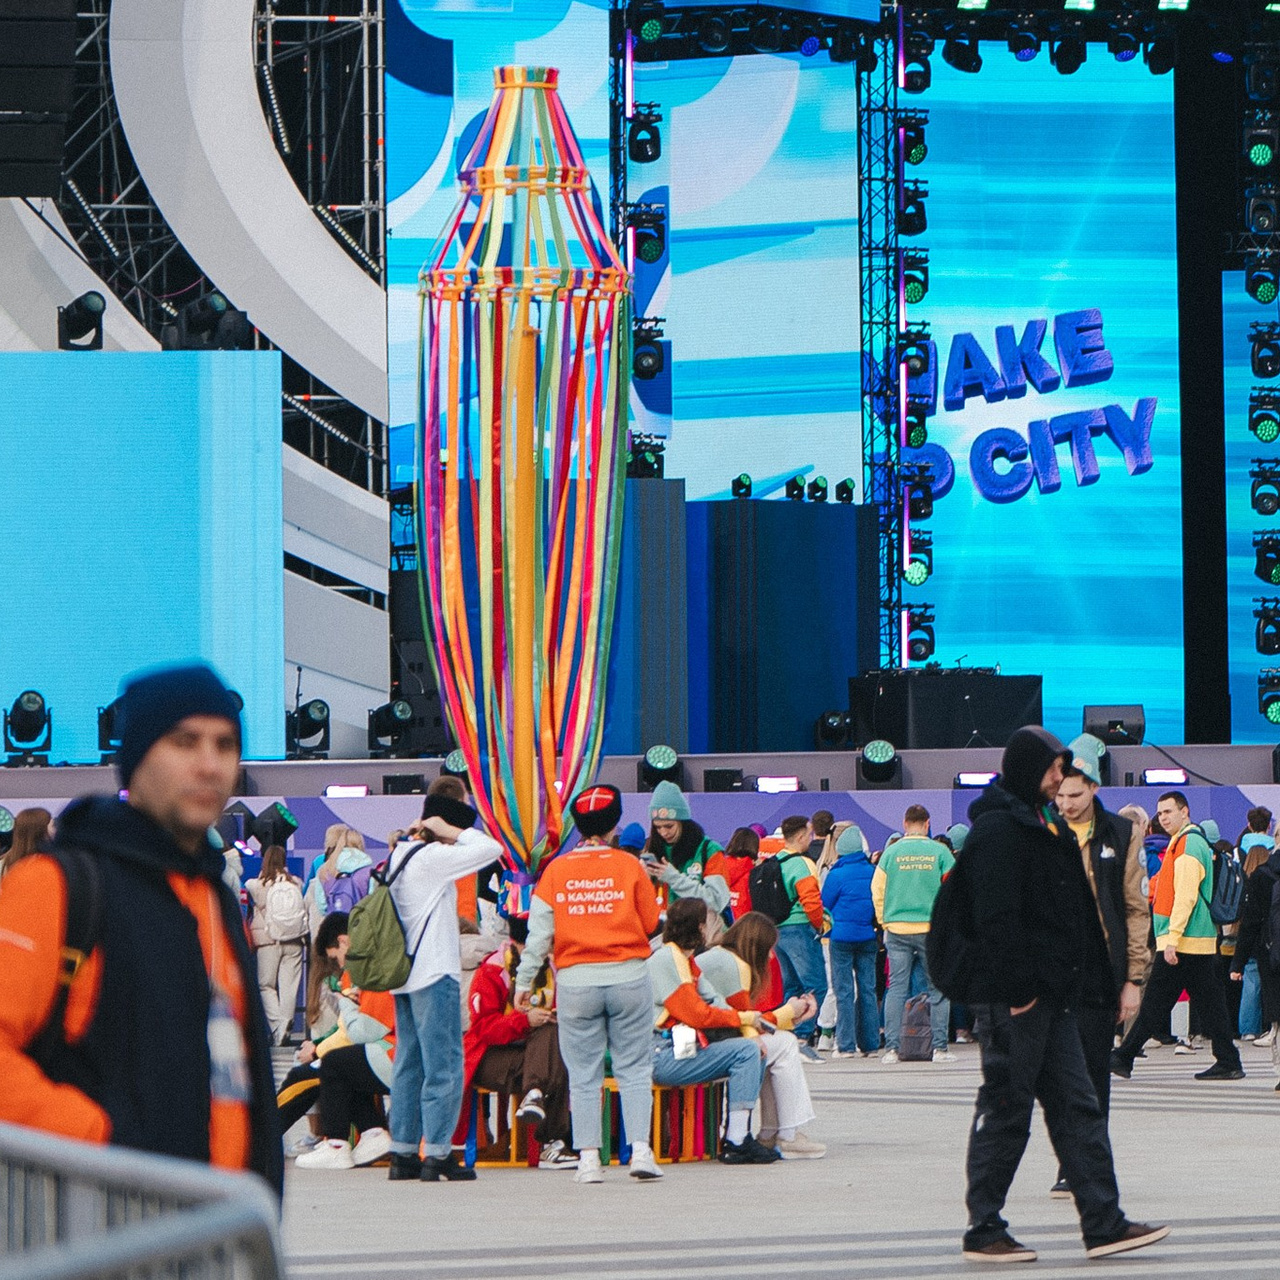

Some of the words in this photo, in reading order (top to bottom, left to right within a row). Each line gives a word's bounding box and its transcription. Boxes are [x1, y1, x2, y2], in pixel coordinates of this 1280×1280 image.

[969, 396, 1158, 504] CITY
[565, 878, 614, 890] СМЫСЛ
[556, 892, 565, 902] В
[567, 890, 625, 902] КАЖДОМ
[568, 904, 585, 915] ИЗ
[587, 903, 614, 914] НАС
